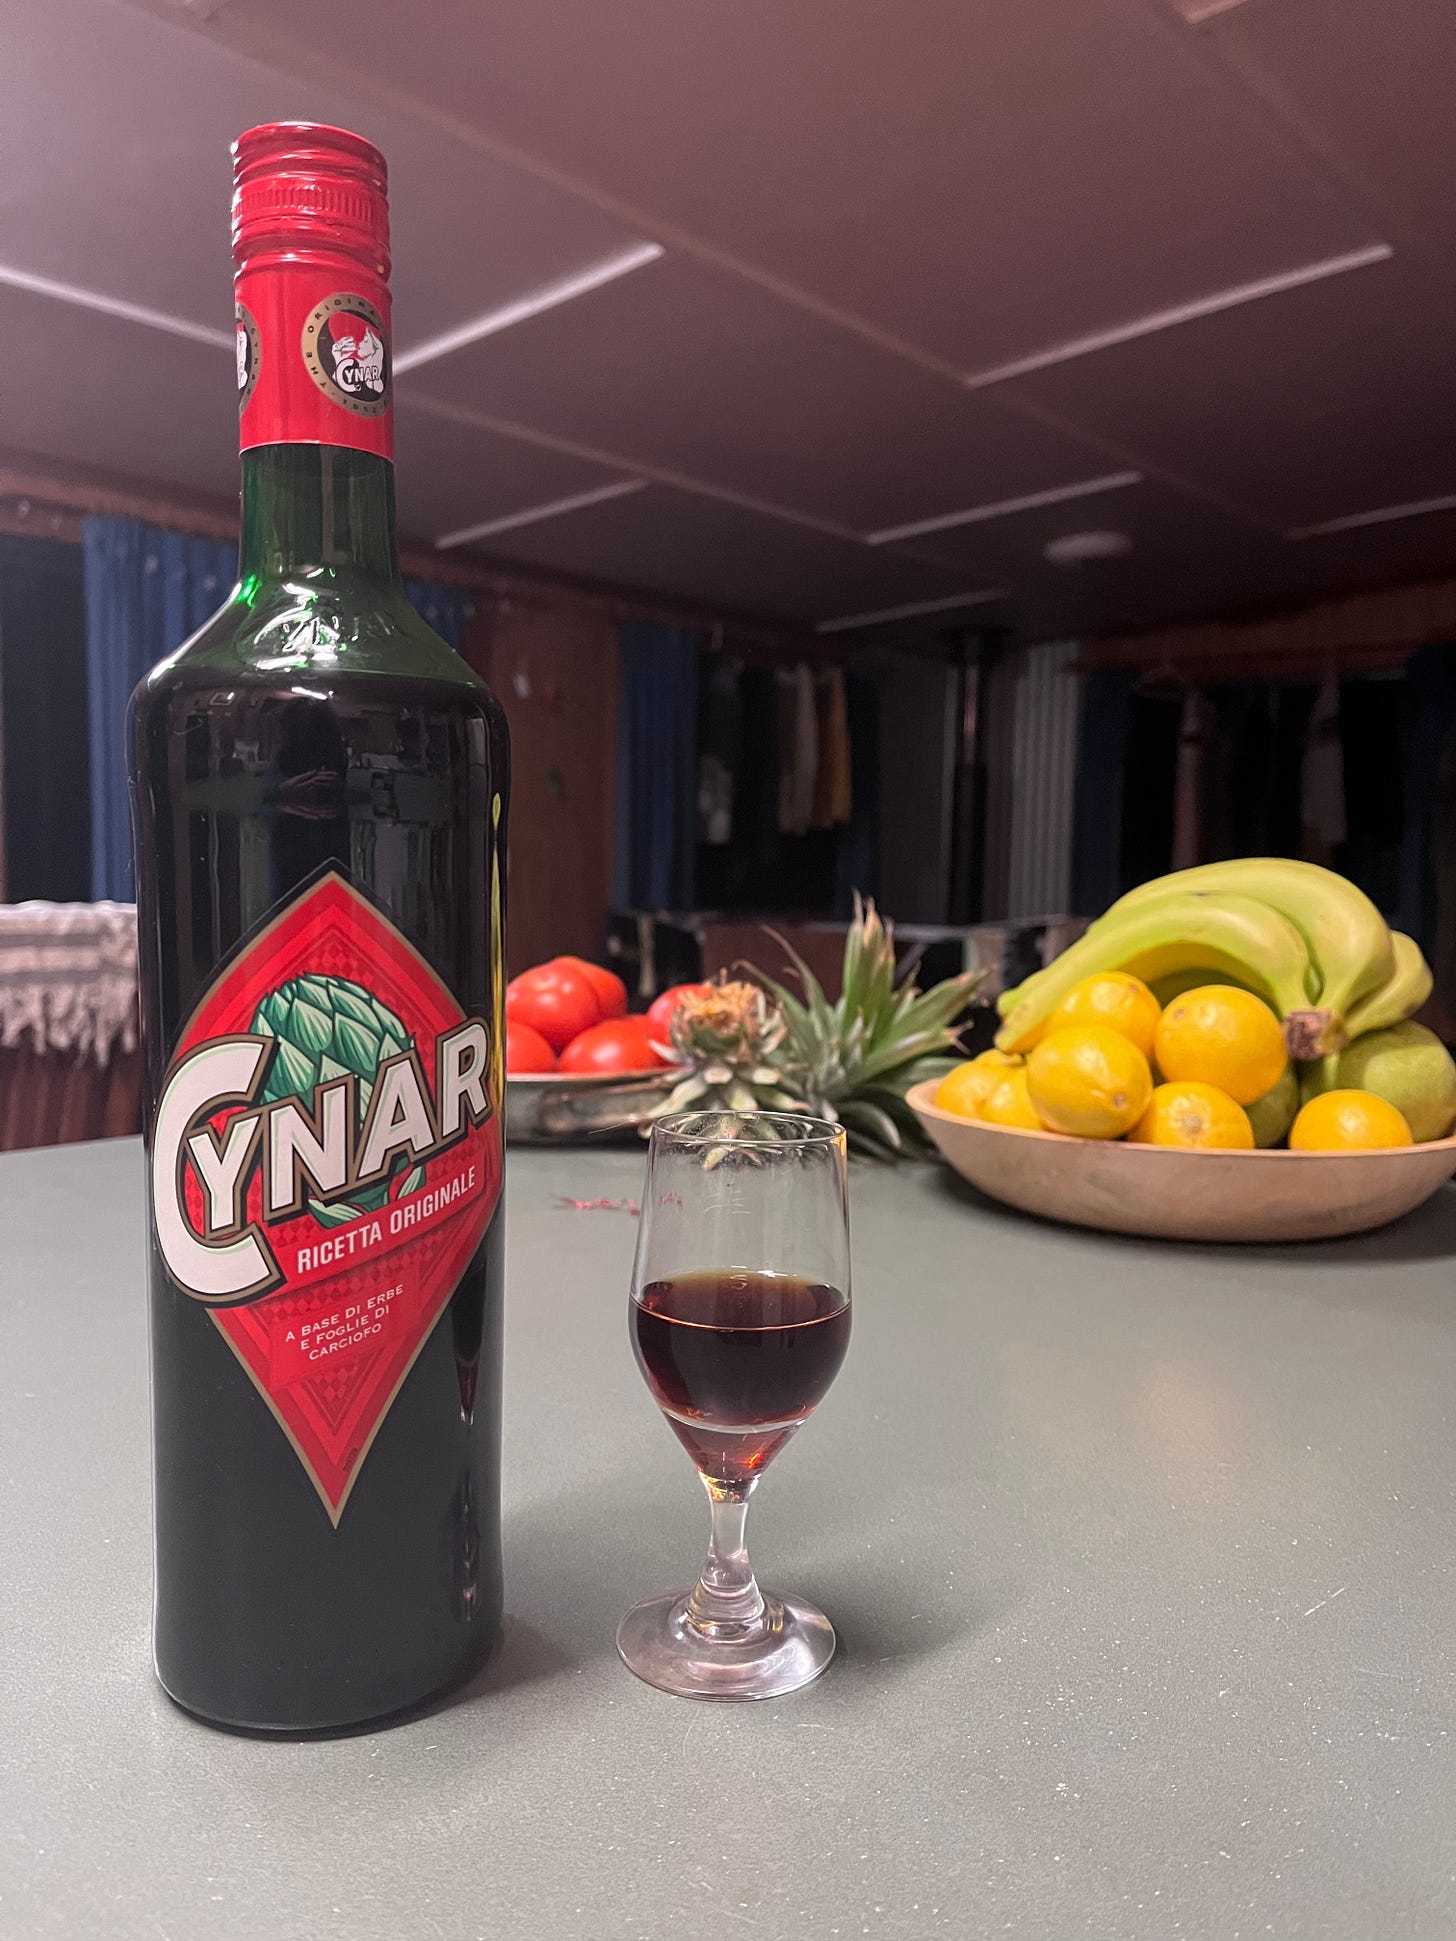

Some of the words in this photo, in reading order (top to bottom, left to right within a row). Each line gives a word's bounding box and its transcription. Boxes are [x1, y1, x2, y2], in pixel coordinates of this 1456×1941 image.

[336, 358, 380, 393] CYNAR
[152, 1018, 493, 1304] CYNAR
[297, 1221, 383, 1273] RICETTA
[390, 1165, 476, 1234] ORIGINALE
[285, 1331, 296, 1342] A
[301, 1314, 340, 1336] BASE
[345, 1305, 361, 1319] DI
[367, 1284, 404, 1309] ERBE
[300, 1339, 310, 1351] E
[316, 1315, 369, 1344] FOGLIE
[375, 1305, 390, 1319] DI
[308, 1323, 382, 1360] CARCIOFO
